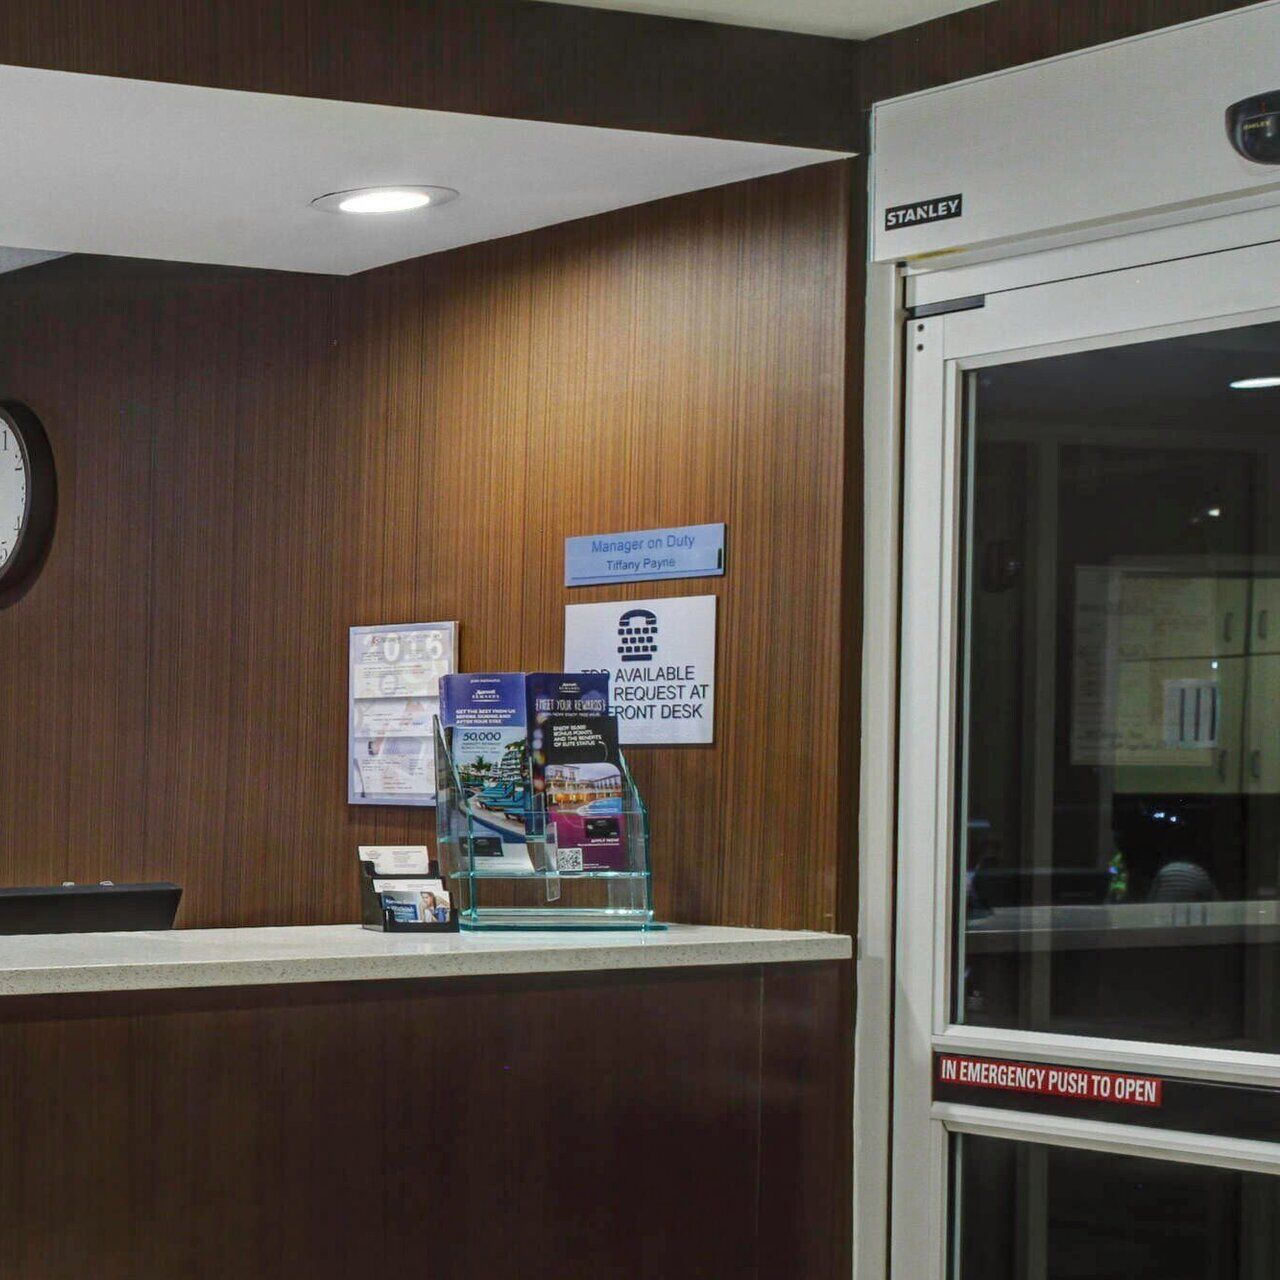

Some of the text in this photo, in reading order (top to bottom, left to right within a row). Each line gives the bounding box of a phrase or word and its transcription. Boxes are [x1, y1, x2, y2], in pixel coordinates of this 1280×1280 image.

[886, 199, 960, 226] STANLEY
[2, 429, 8, 452] 1
[591, 534, 696, 554] Manager on Duty
[606, 557, 677, 572] Tiffany Payne
[614, 665, 696, 683] AVAILABLE
[613, 684, 710, 701] REQUEST AT
[661, 703, 704, 719] DESK
[462, 731, 502, 742] 50,000
[941, 1059, 1157, 1103] IN EMERGENCY PUSH TO OPEN
